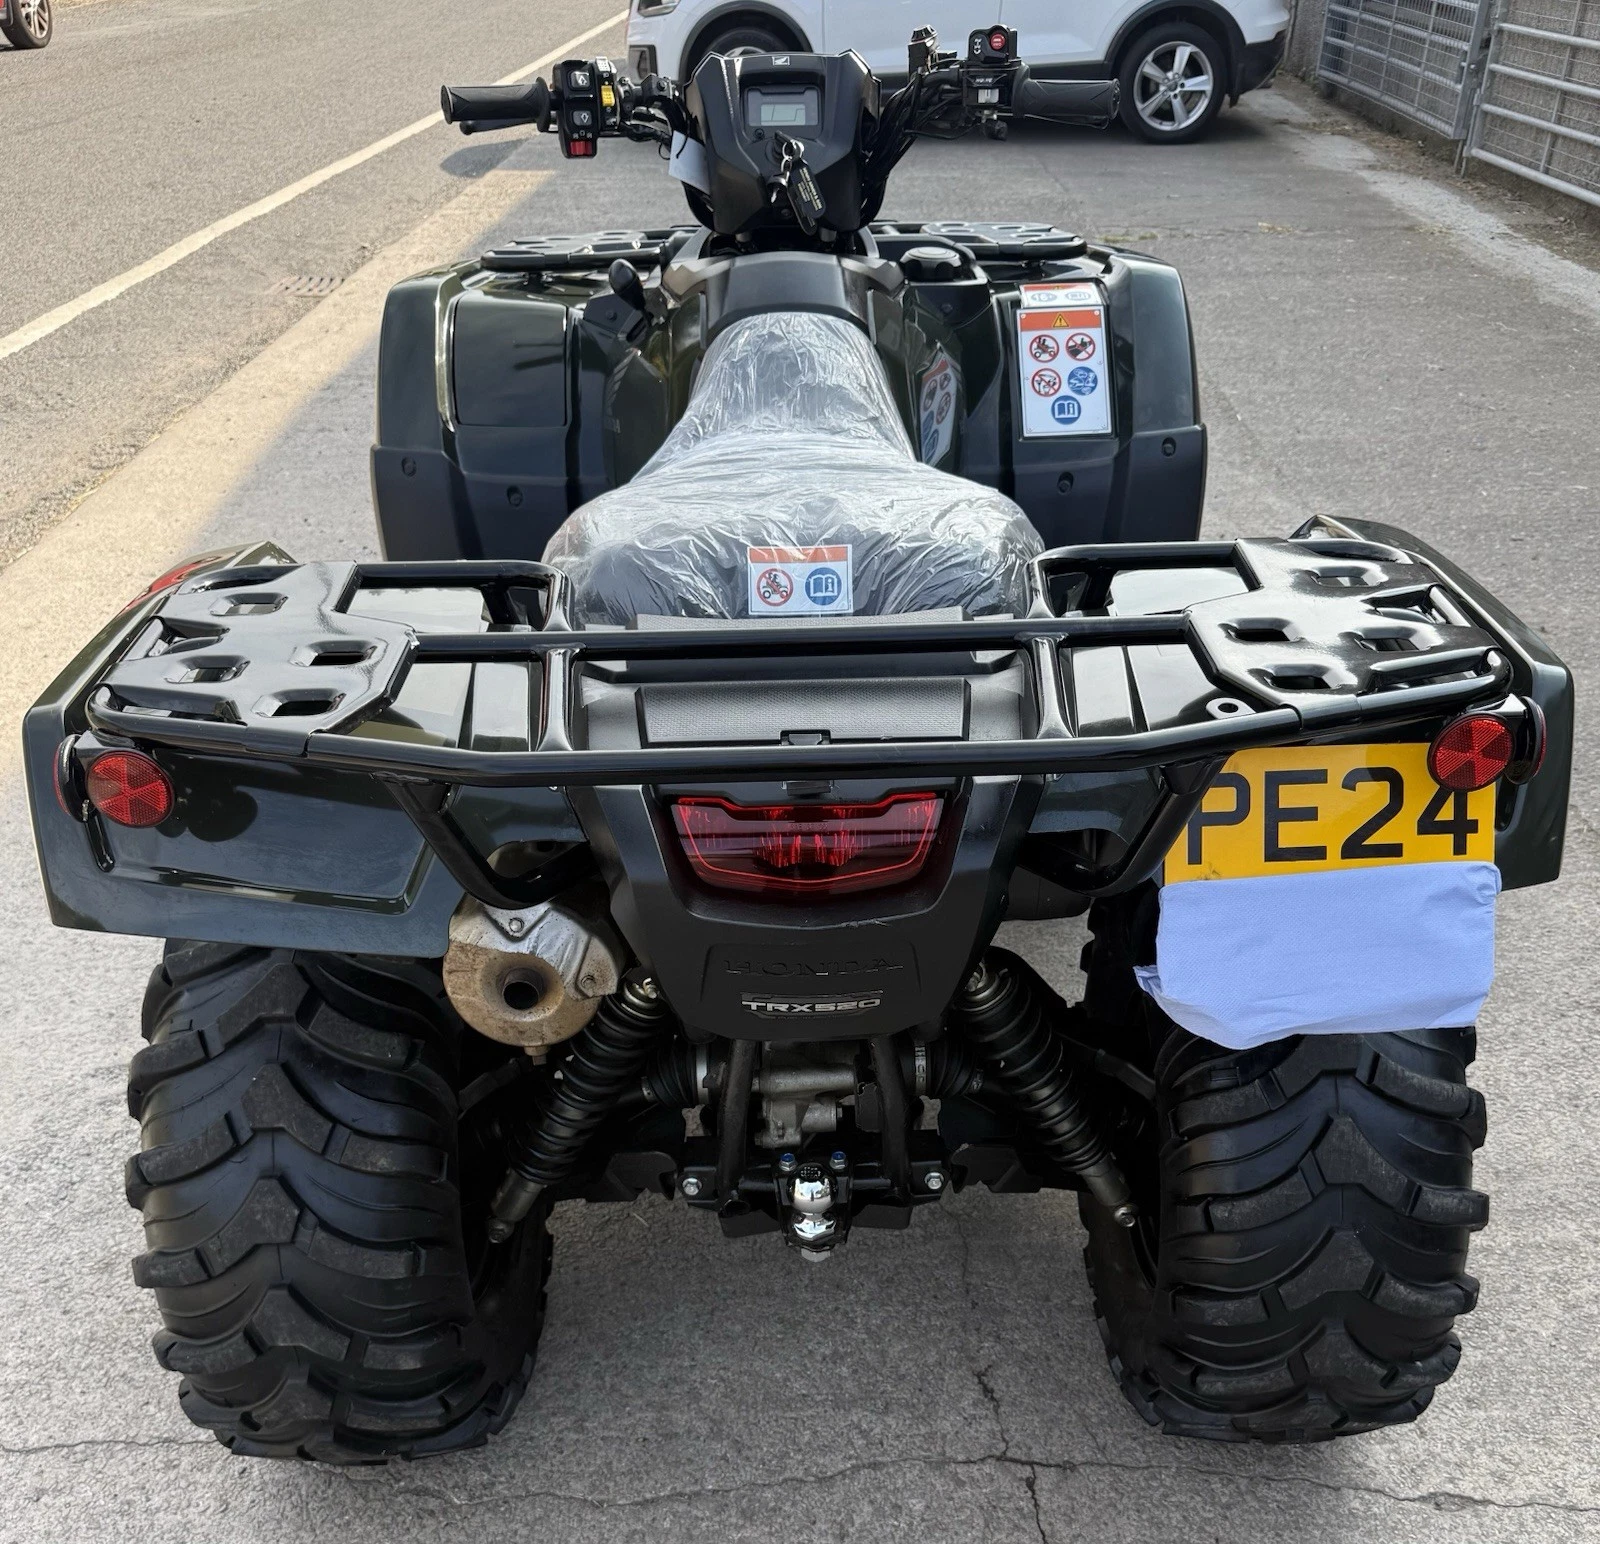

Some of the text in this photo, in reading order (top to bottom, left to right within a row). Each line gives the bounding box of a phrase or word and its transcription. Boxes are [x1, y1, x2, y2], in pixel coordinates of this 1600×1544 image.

[1187, 766, 1479, 866] PE24
[723, 958, 904, 976] HONDA
[741, 998, 881, 1013] TRX520
